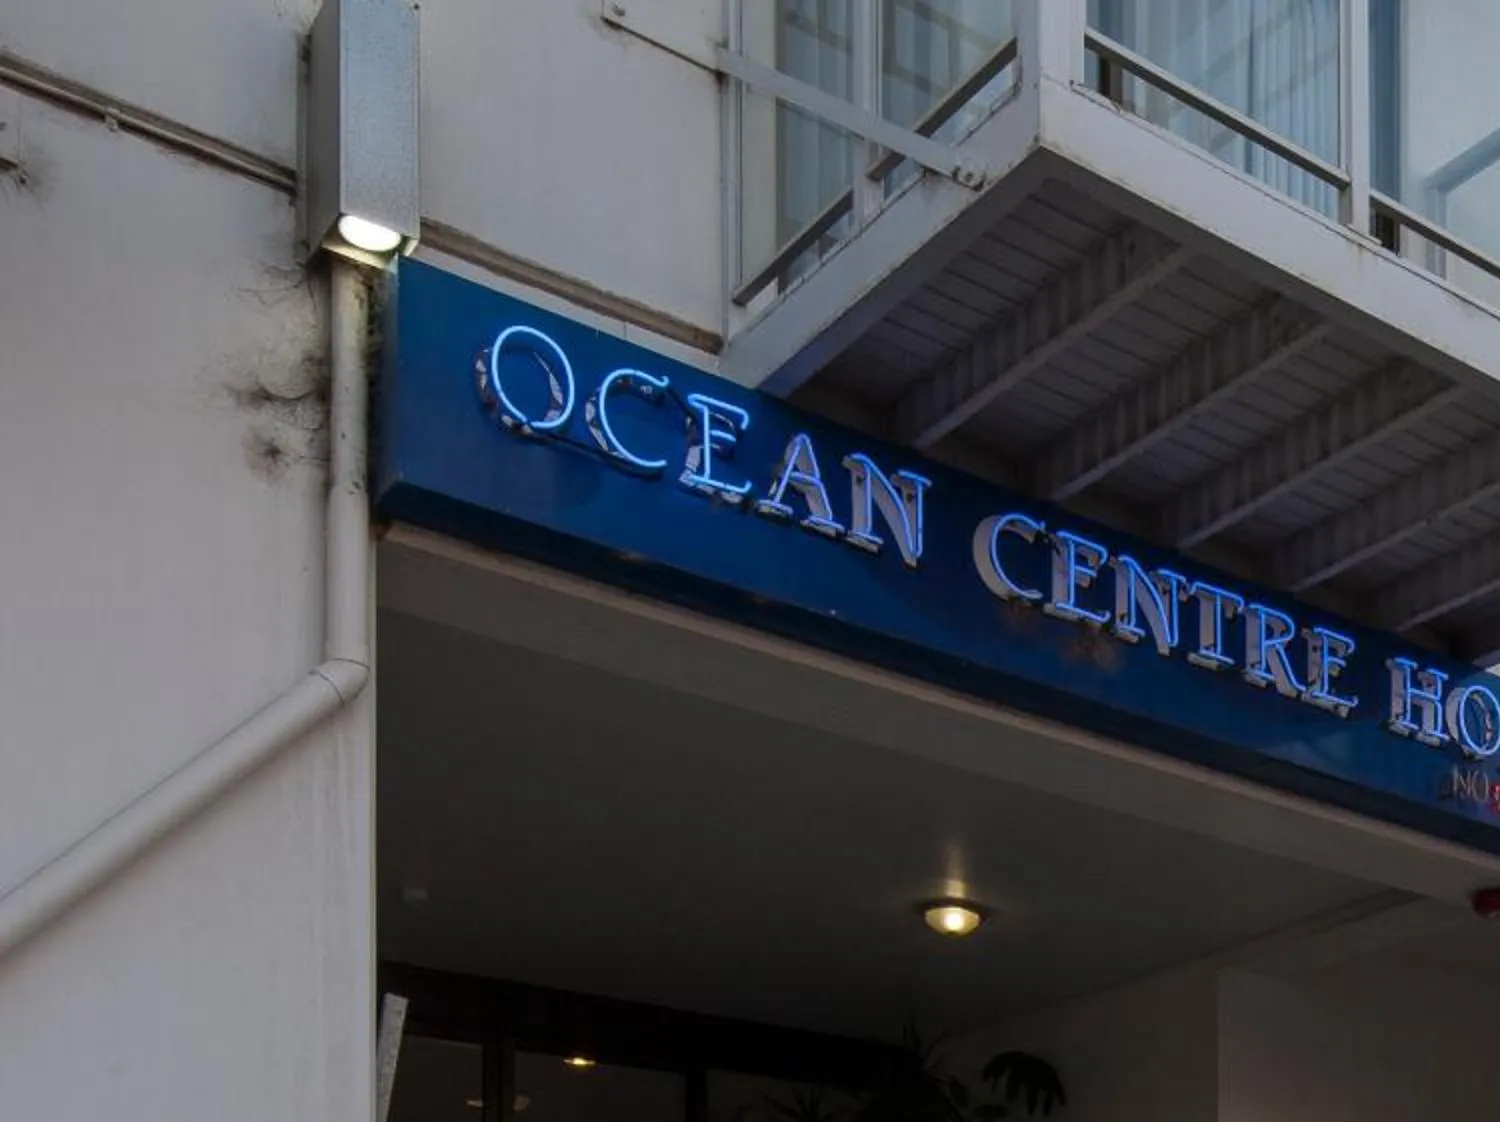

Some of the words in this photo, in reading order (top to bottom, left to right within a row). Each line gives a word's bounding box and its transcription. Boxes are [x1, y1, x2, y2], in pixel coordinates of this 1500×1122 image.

[475, 324, 933, 569] OCEAN
[973, 512, 1359, 720] CENTRE
[1451, 764, 1489, 803] NO
